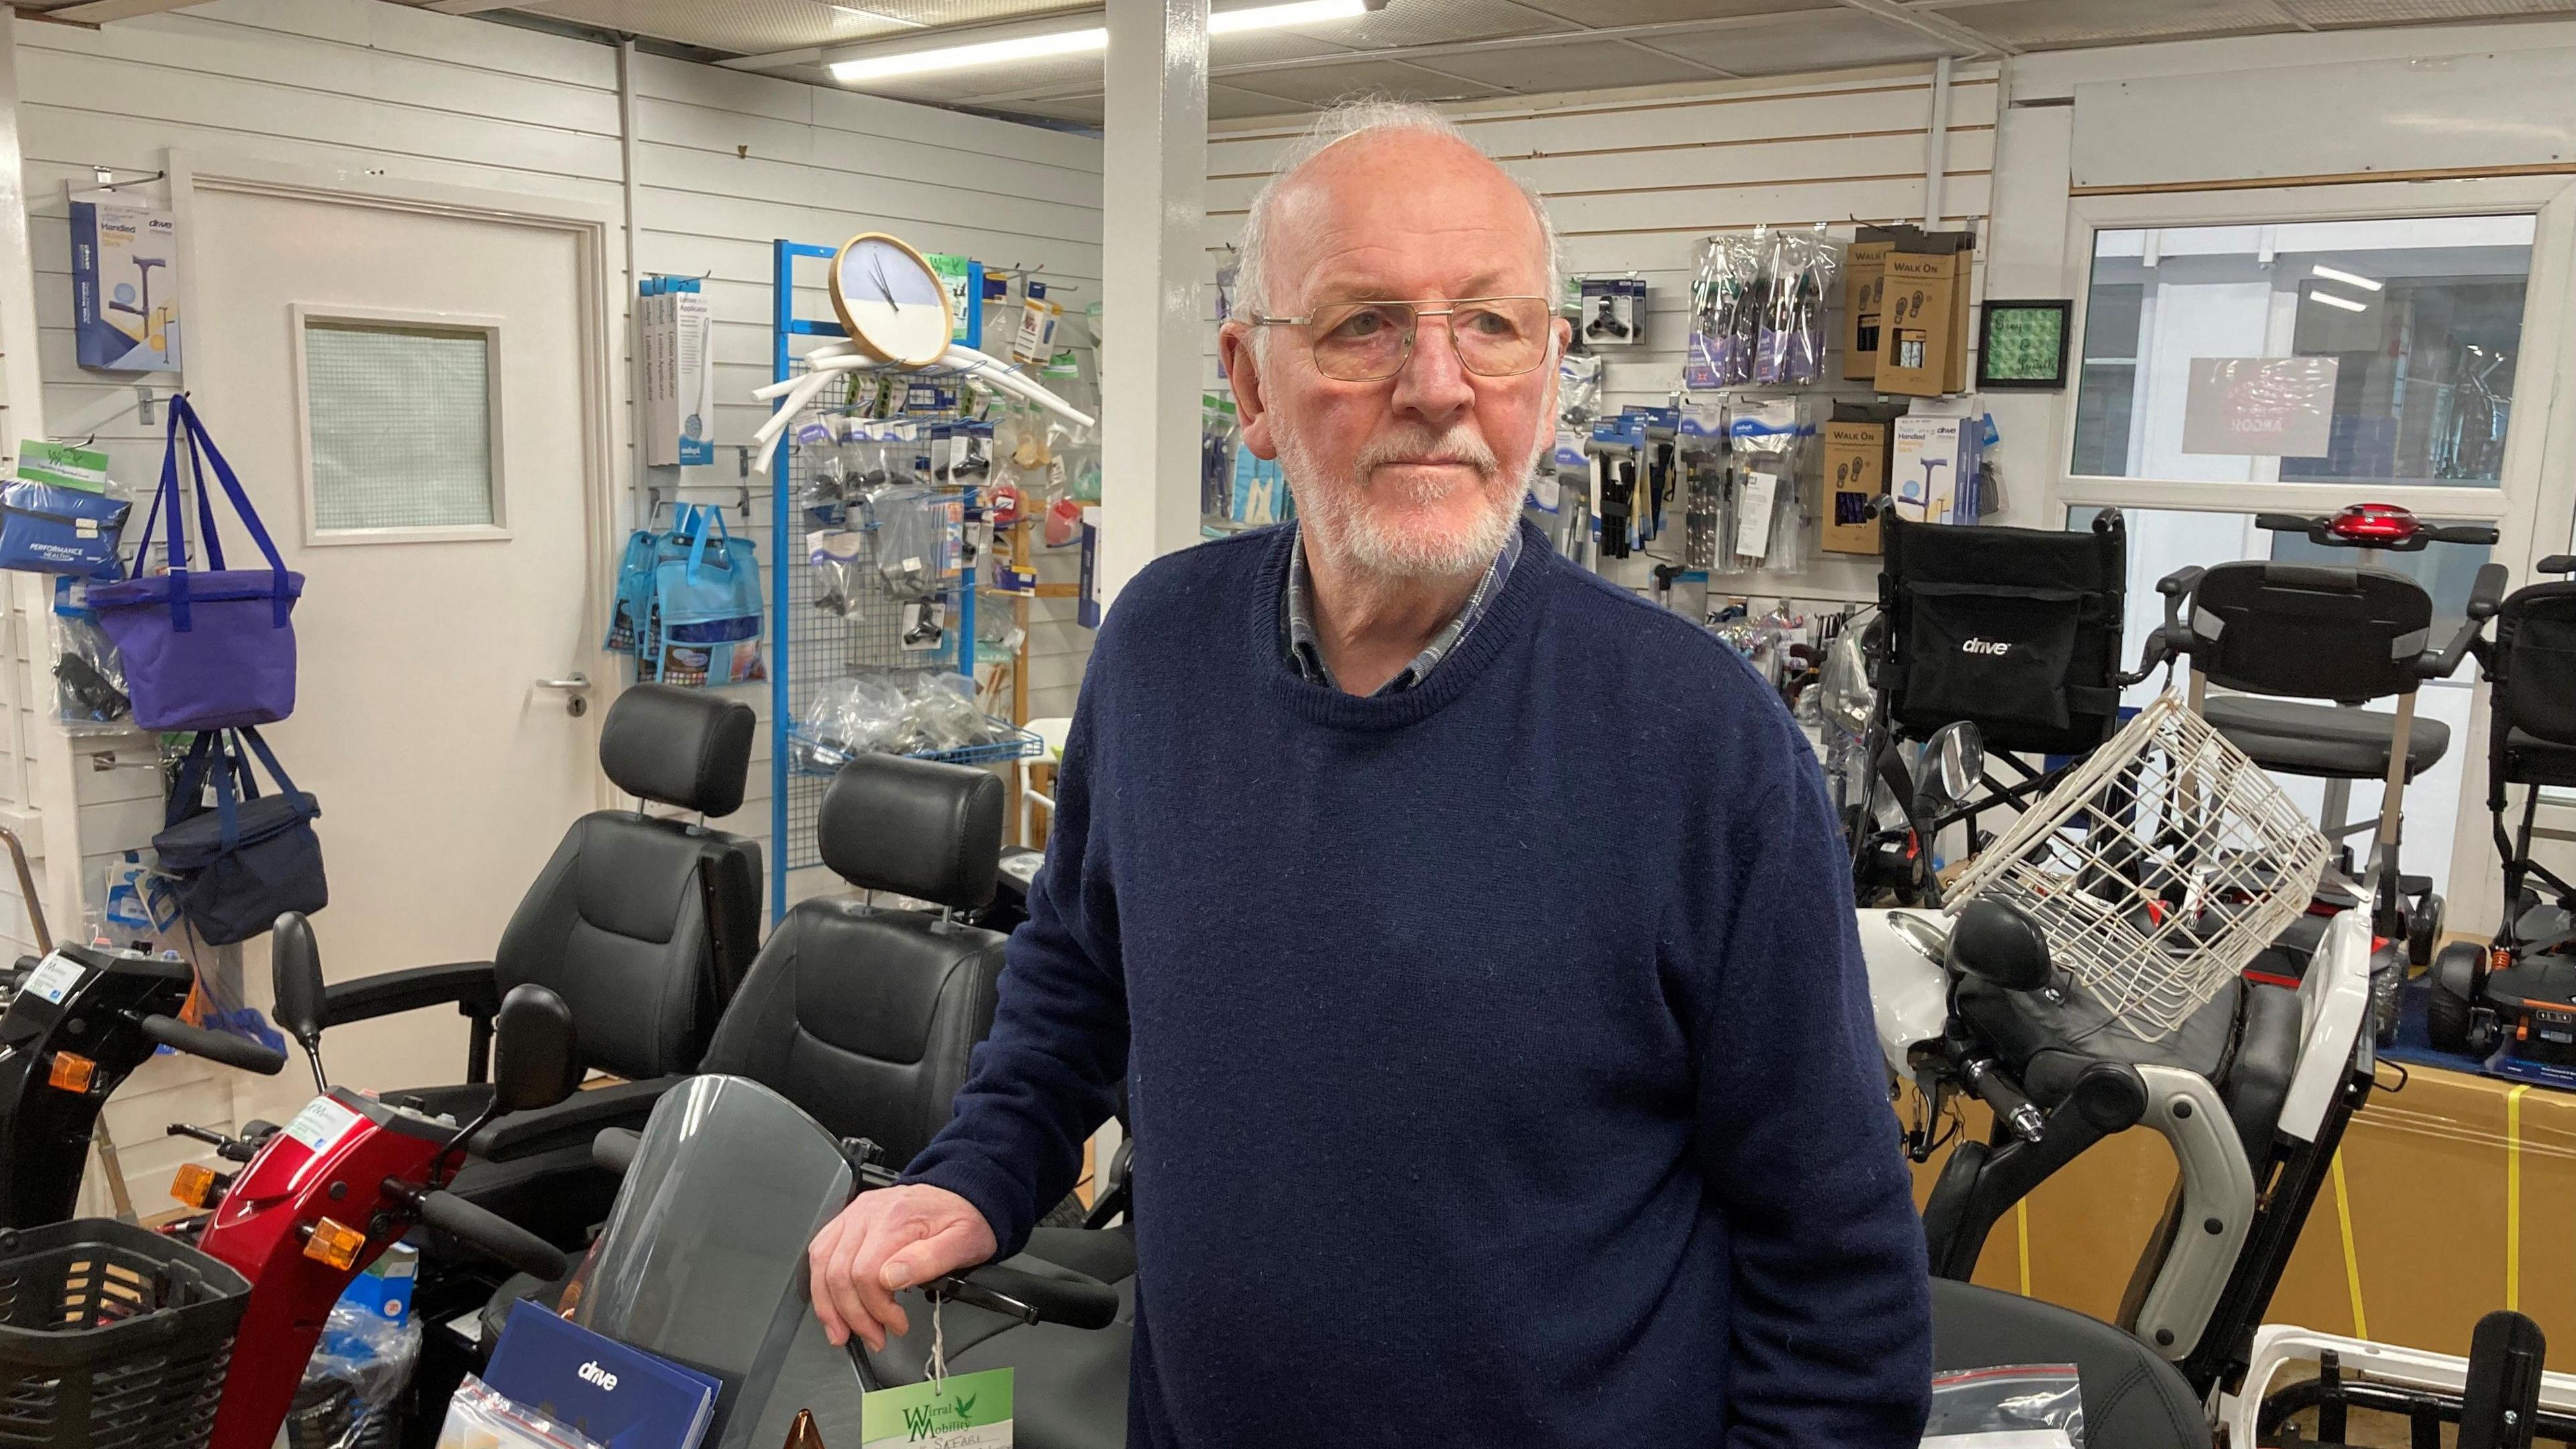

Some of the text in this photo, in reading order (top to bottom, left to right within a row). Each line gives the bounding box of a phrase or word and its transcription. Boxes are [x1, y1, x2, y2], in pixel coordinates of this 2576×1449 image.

[101, 222, 136, 233] Handled
[149, 219, 172, 229] drive
[1856, 252, 1880, 261] WALK
[1894, 262, 1938, 274] WALK ON
[1833, 431, 1874, 441] WALK ON
[30, 543, 84, 556] PERFORMANCE
[1962, 637, 2008, 655] drive
[578, 1360, 618, 1391] drive
[902, 1403, 953, 1430] Wirral
[908, 1417, 971, 1443] Mobility
